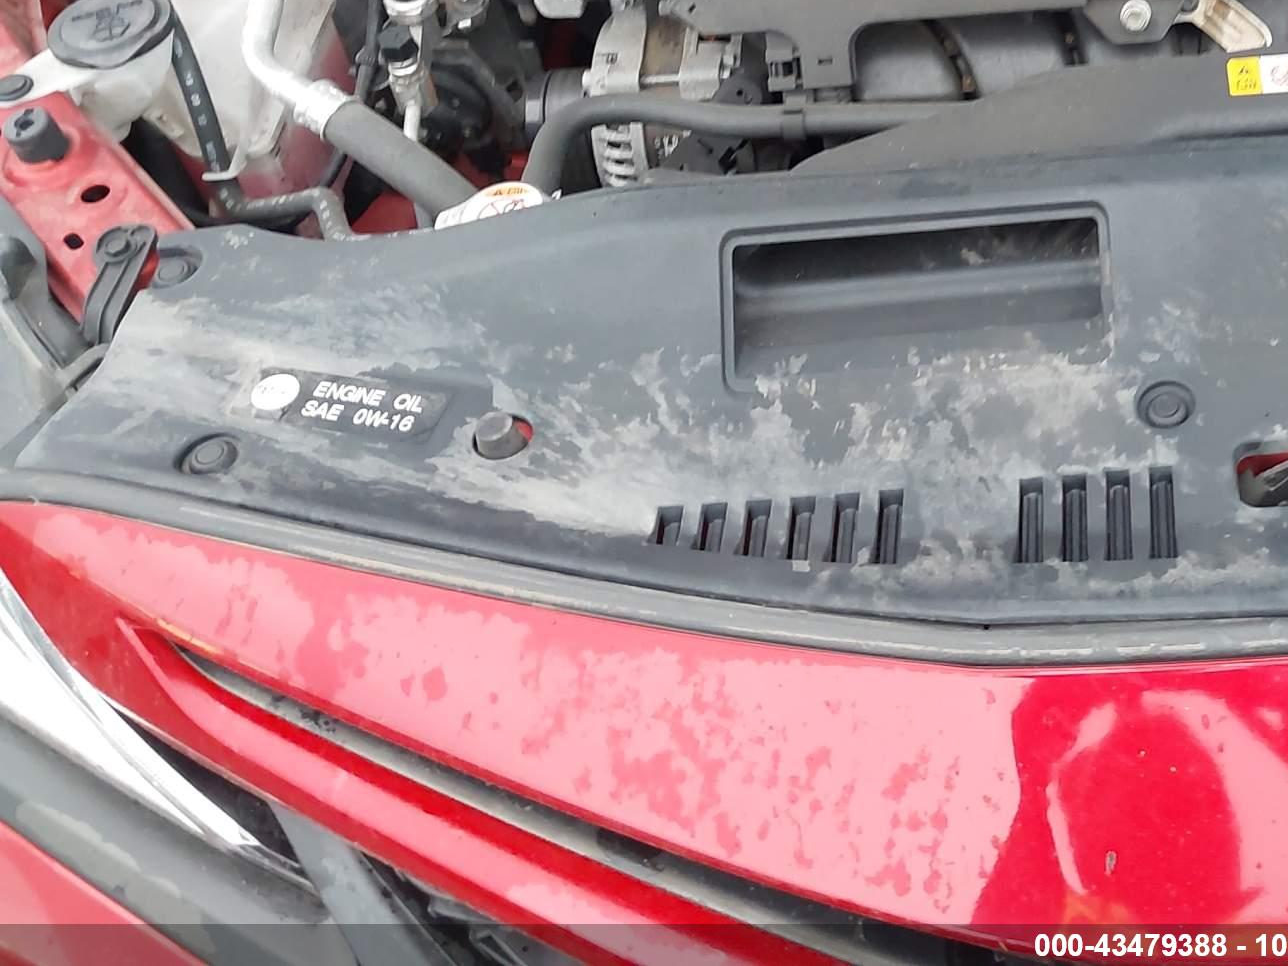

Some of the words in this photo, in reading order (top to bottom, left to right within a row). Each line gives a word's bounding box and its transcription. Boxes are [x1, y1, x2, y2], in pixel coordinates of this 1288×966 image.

[312, 380, 386, 407] ENGINE
[393, 392, 424, 414] OIL
[300, 399, 345, 422] SAE
[352, 408, 415, 433] 0W-16
